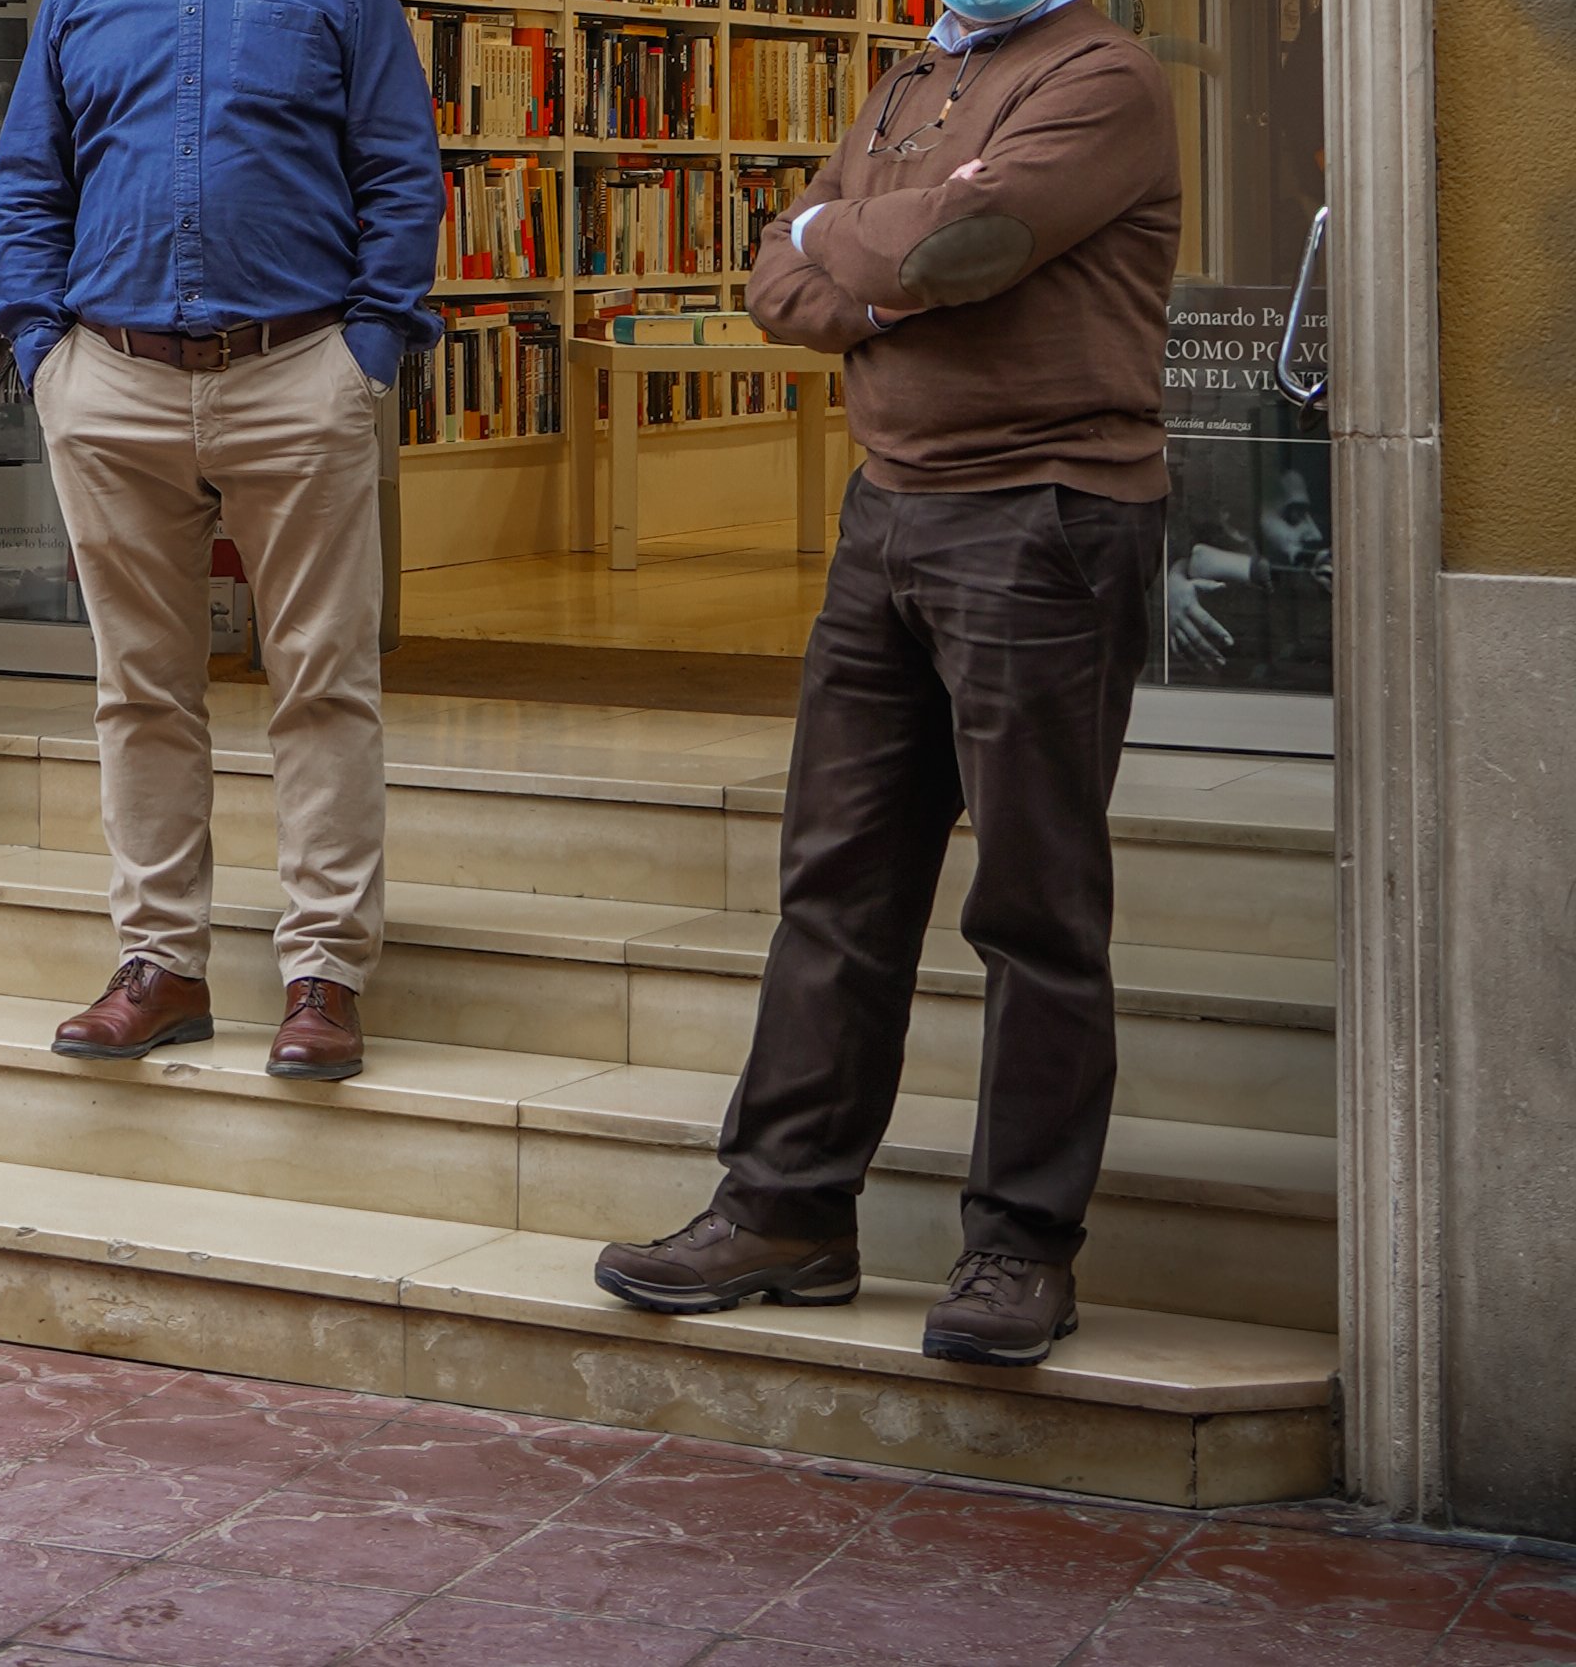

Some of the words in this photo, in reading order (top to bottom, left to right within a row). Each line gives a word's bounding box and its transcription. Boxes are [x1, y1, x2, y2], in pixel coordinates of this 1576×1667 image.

[1166, 306, 1256, 327] Leonardo
[1165, 338, 1244, 361] COMO
[1164, 367, 1197, 388] EN
[1205, 368, 1237, 389] EL
[1164, 416, 1205, 430] colección
[1207, 418, 1252, 432] andanzas
[24, 538, 35, 548] lo
